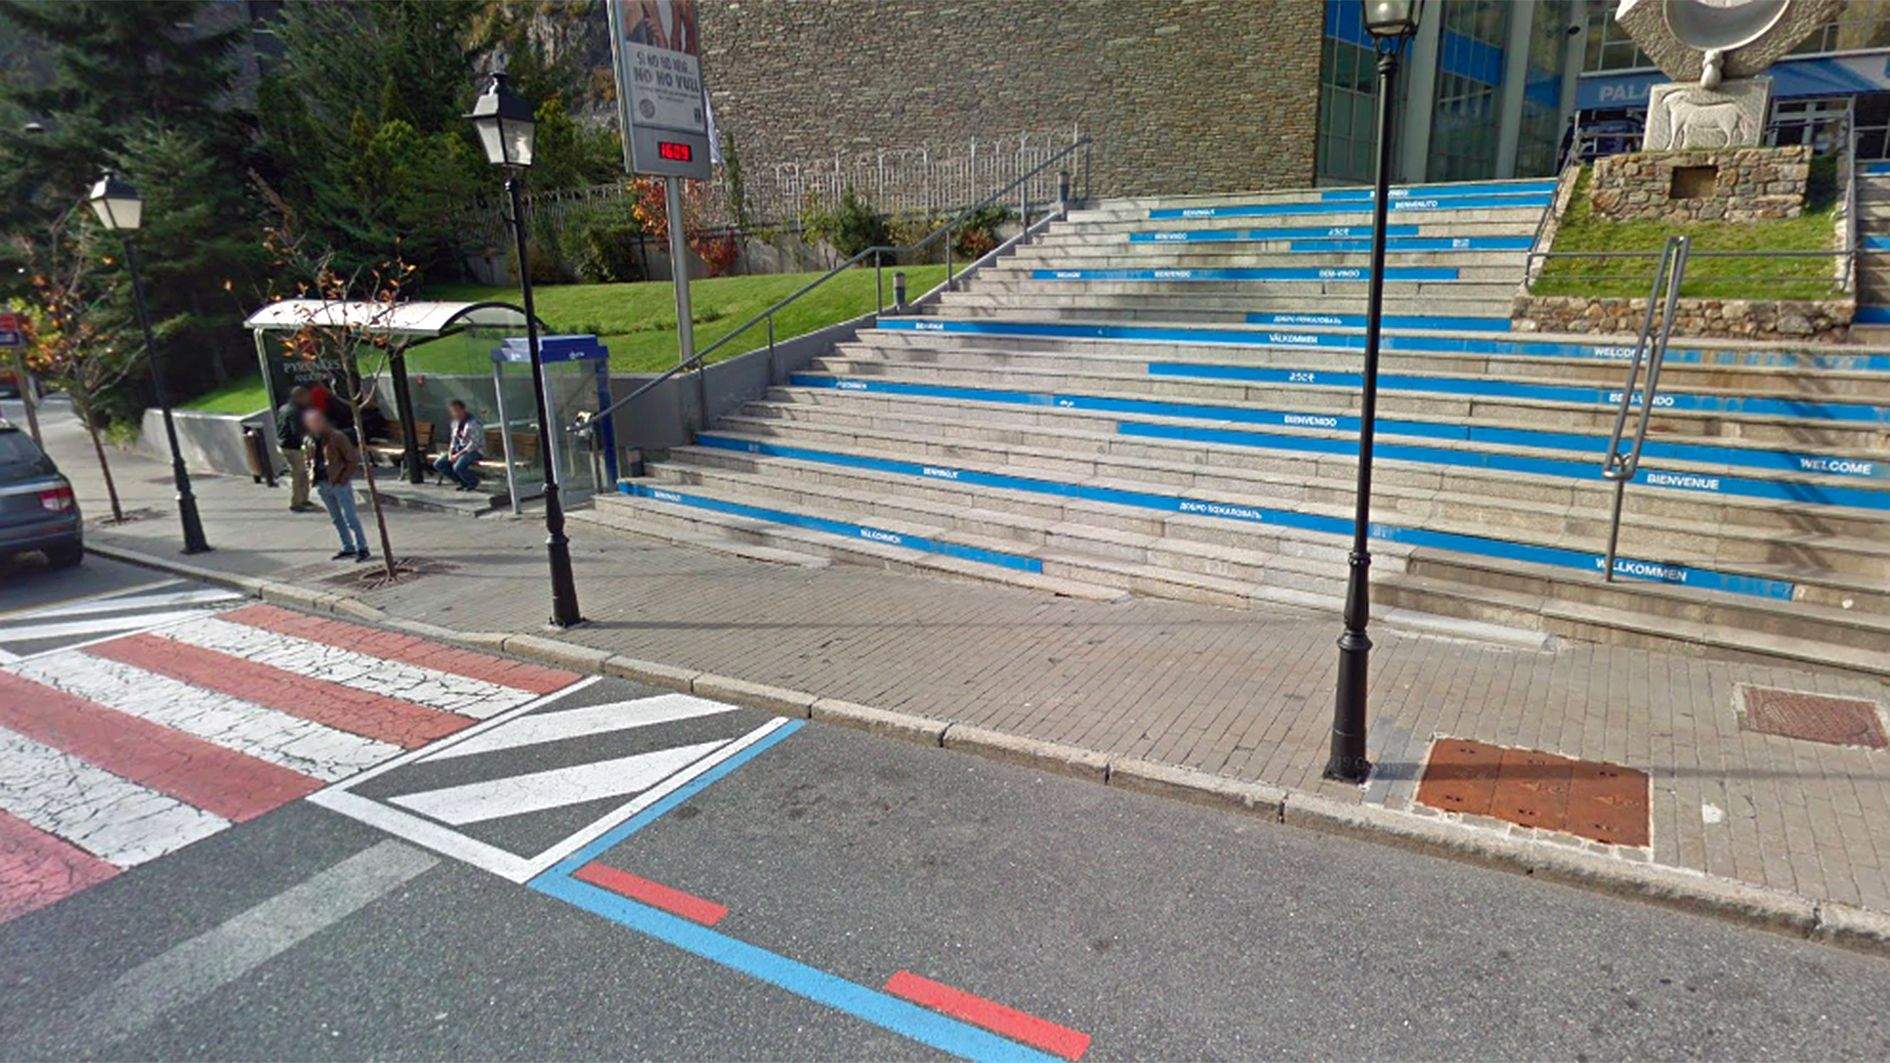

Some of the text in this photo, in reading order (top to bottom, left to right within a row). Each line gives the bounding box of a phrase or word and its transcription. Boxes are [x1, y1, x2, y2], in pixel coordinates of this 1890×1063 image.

[1800, 458, 1872, 476] WELCOME
[1646, 473, 1720, 491] BIENVENUE
[1595, 558, 1688, 581] WLLKOMMEN
